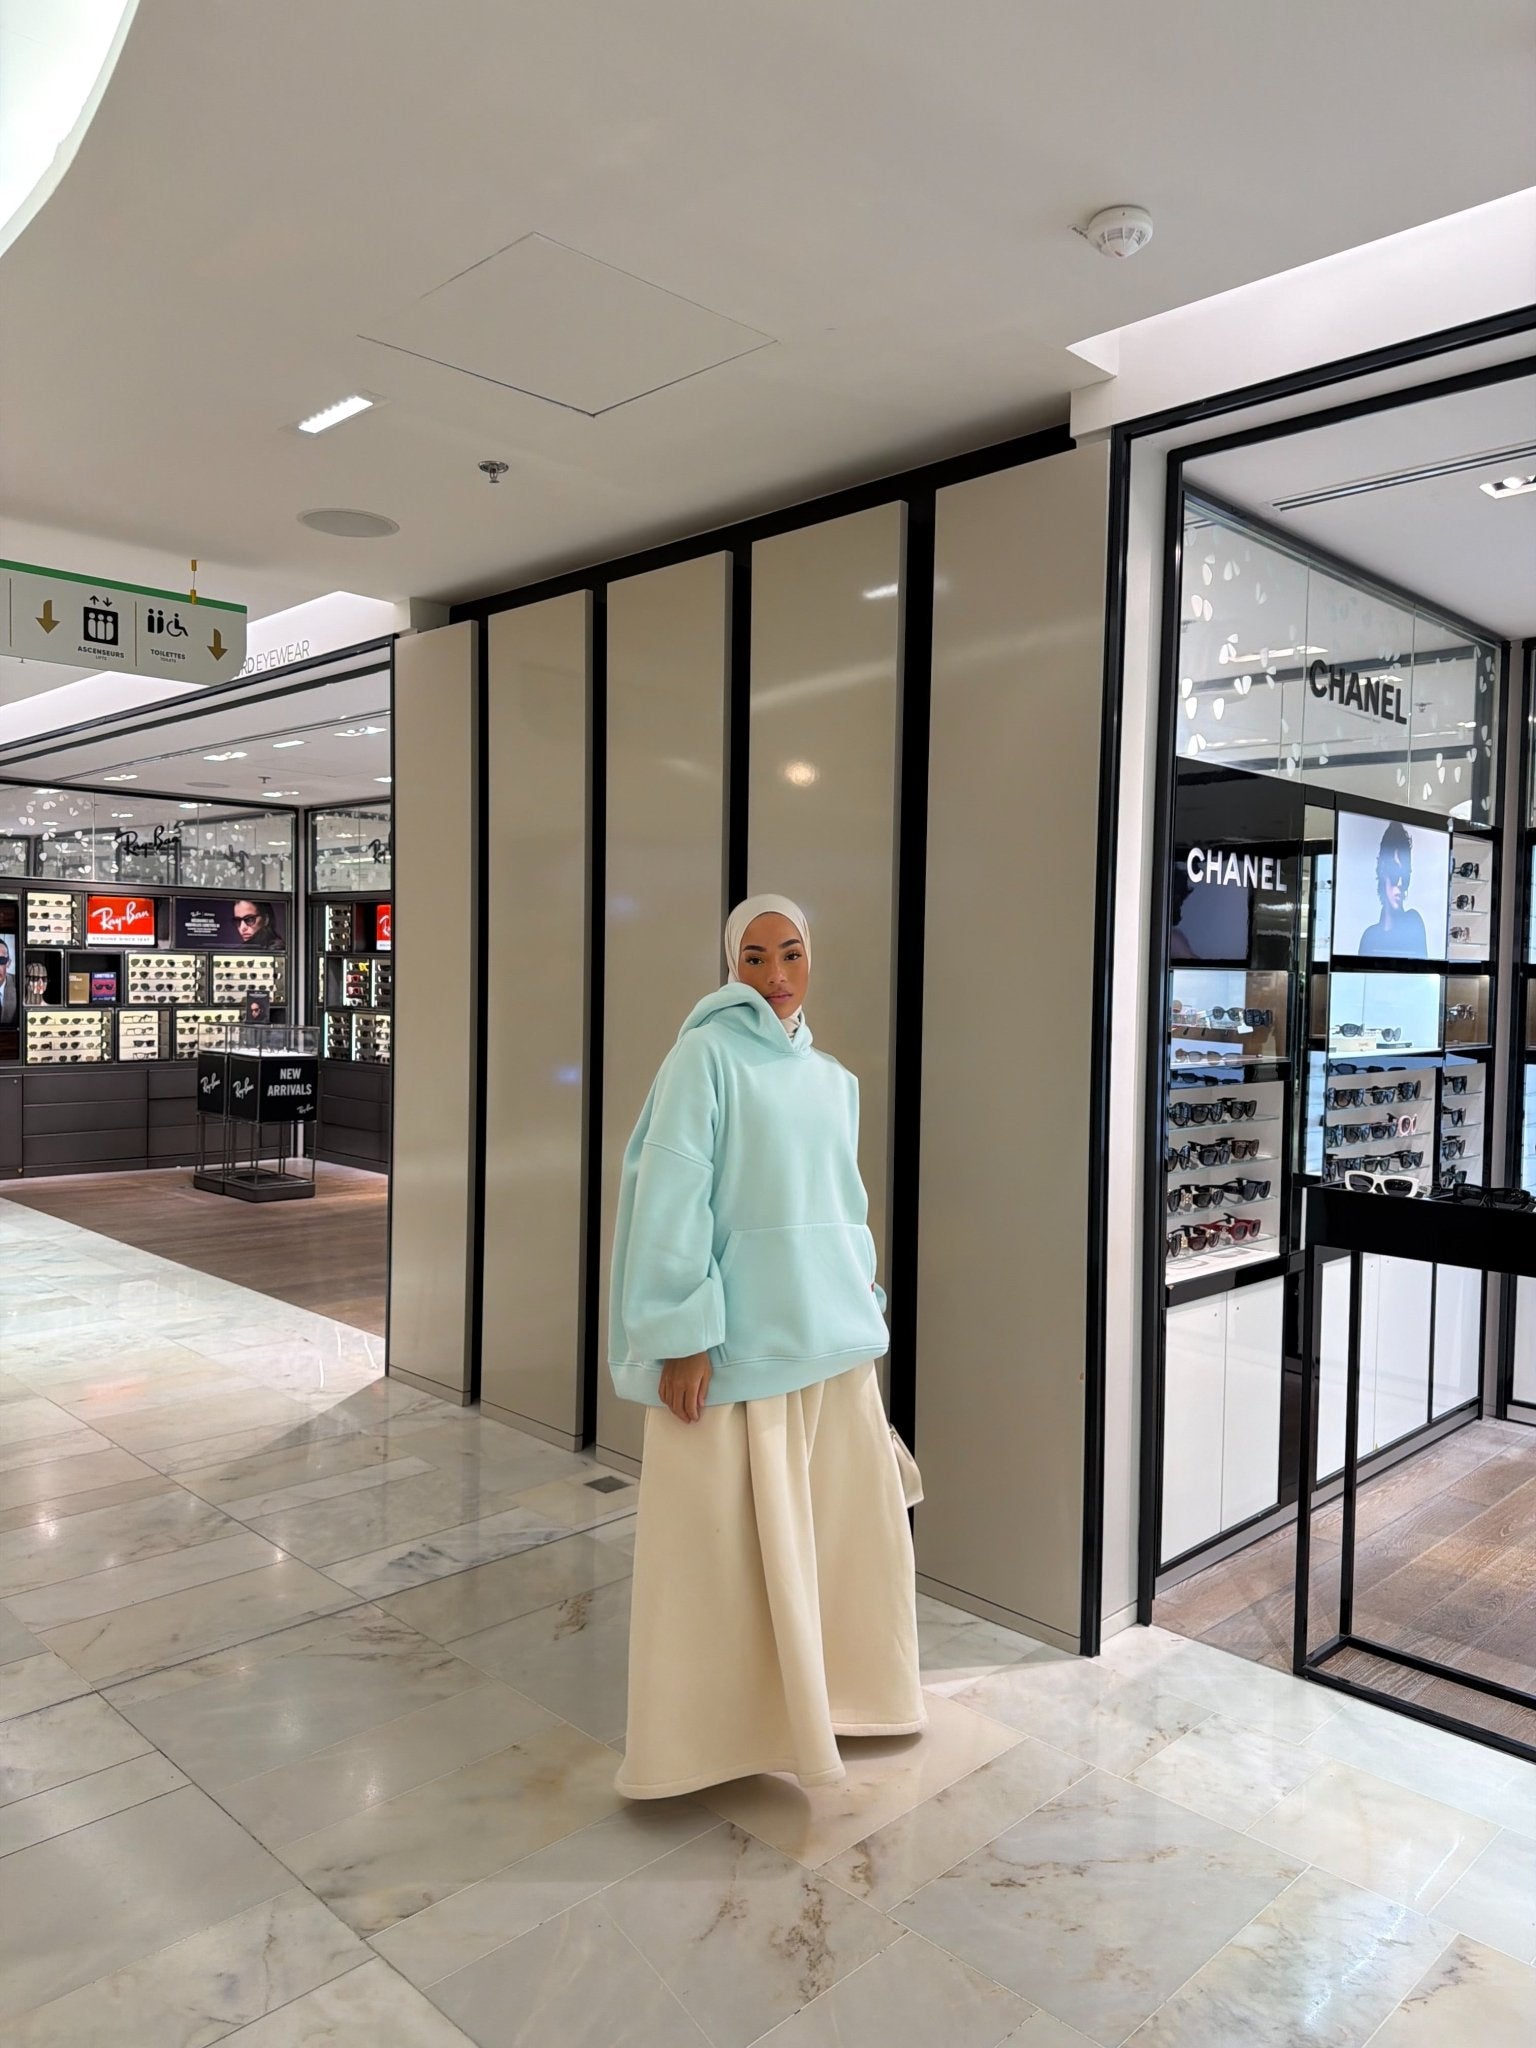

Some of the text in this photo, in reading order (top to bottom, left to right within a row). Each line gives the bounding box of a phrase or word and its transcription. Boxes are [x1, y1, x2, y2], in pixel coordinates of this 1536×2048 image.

[77, 645, 125, 659] ASCENSEURS
[150, 648, 186, 660] TOILETTES
[256, 639, 310, 671] EYEWEAR
[1309, 659, 1407, 725] CHANEL
[1187, 847, 1288, 892] CHANEL
[91, 901, 150, 931] Ray-Ban
[280, 1068, 302, 1080] NEW
[267, 1083, 313, 1097] ARRIVALS
